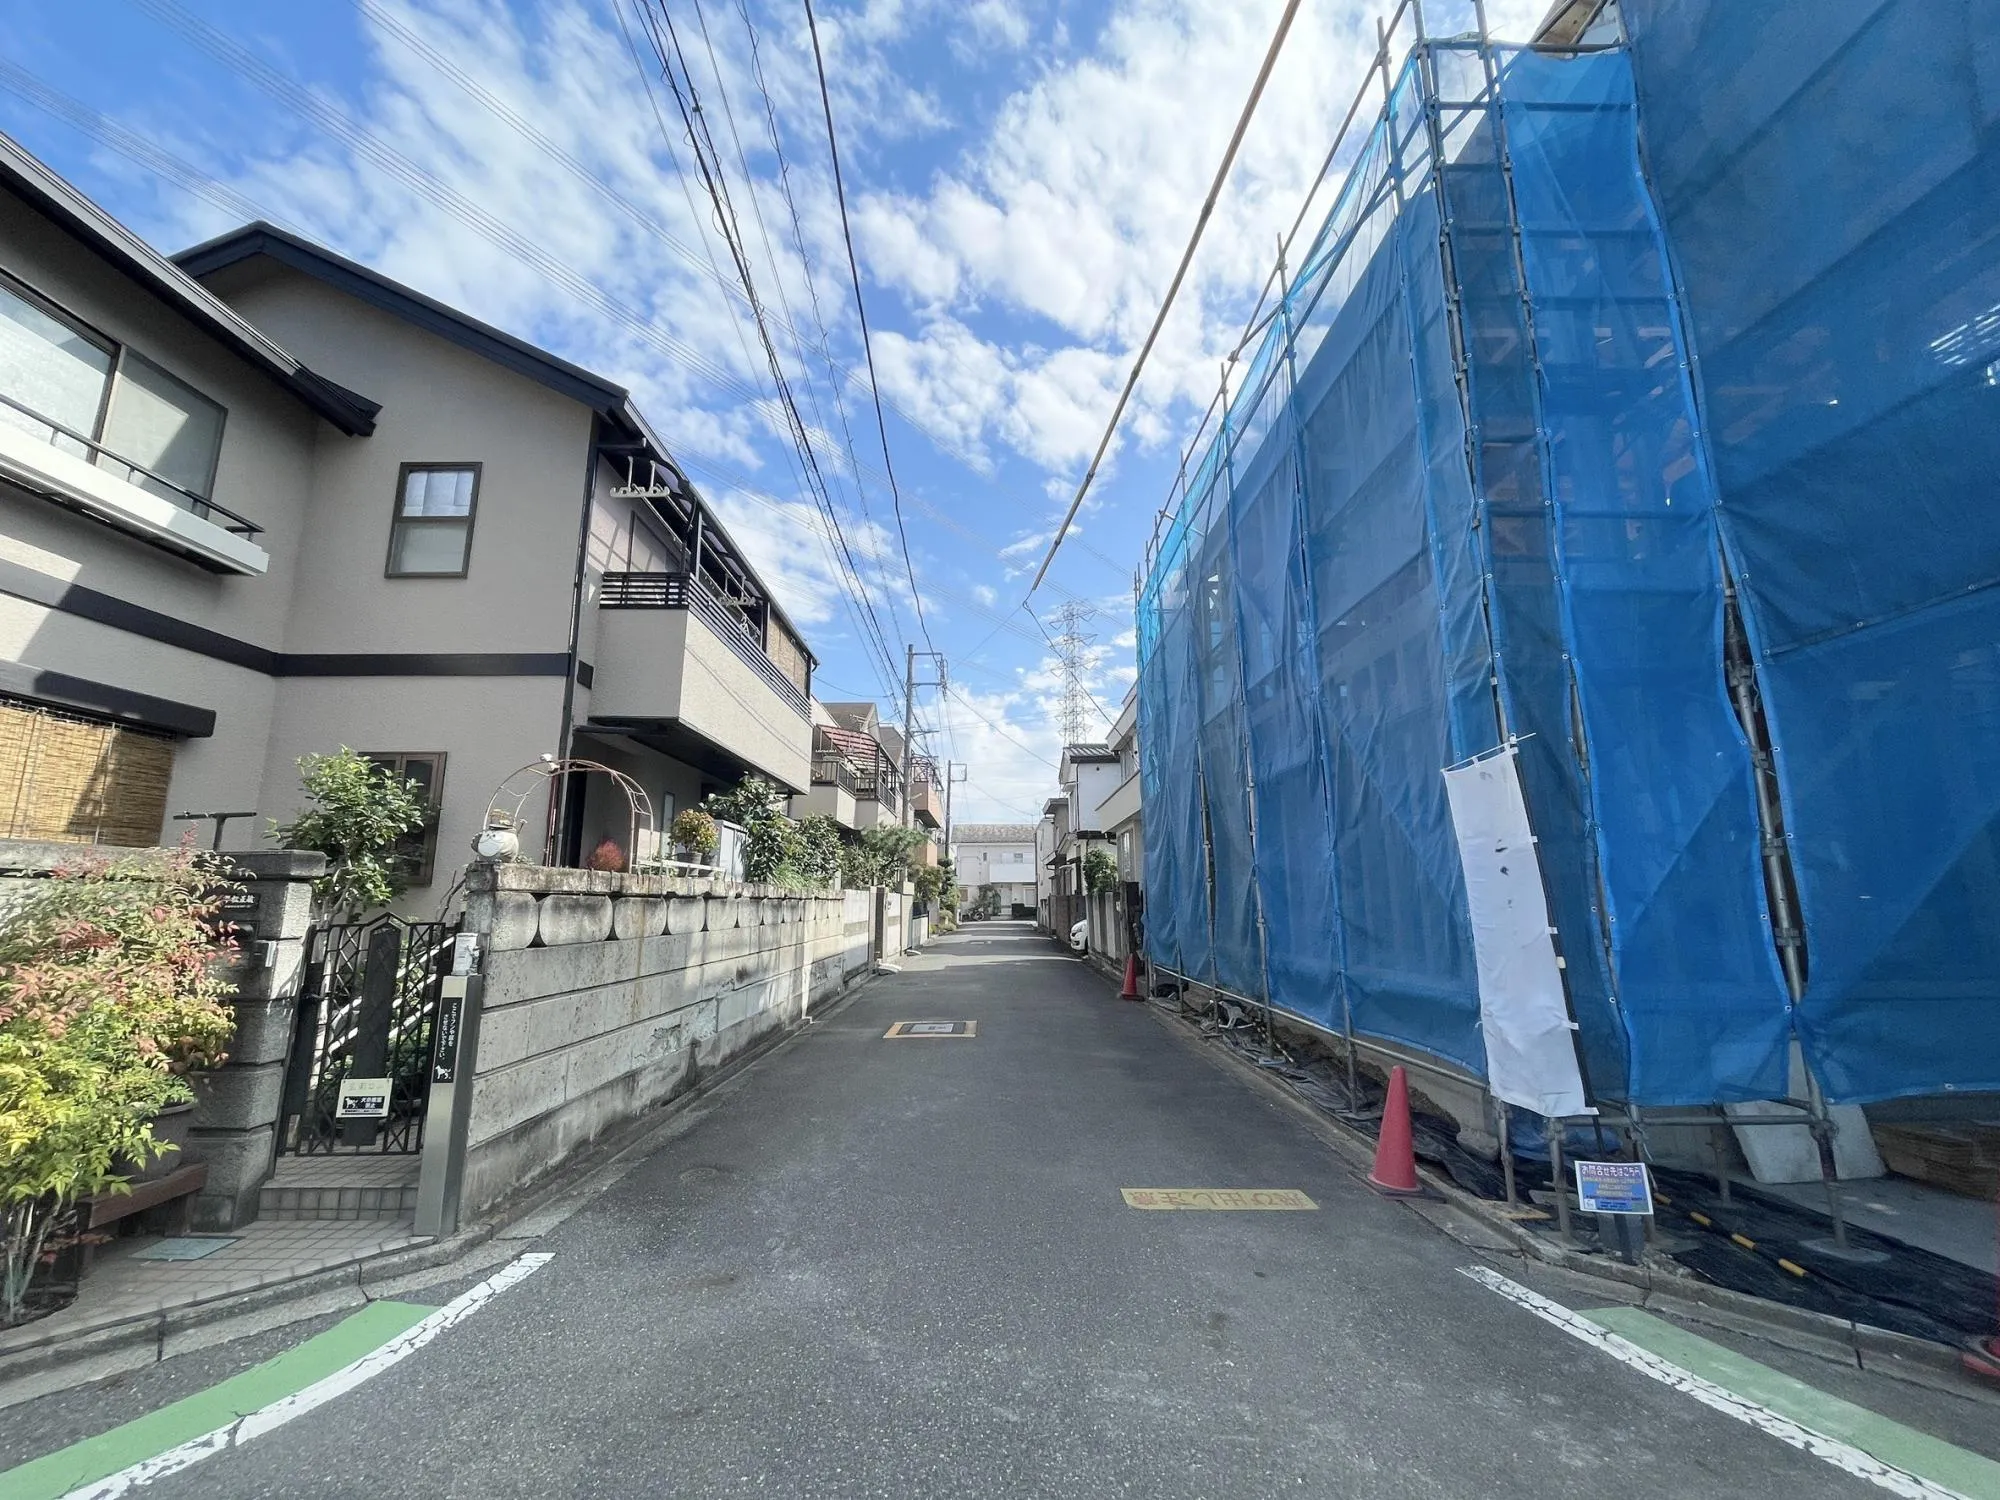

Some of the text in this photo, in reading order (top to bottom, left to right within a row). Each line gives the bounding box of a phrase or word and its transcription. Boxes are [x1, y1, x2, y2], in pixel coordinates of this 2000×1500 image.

[1581, 1165, 1641, 1177] お問合せ先はこちら
